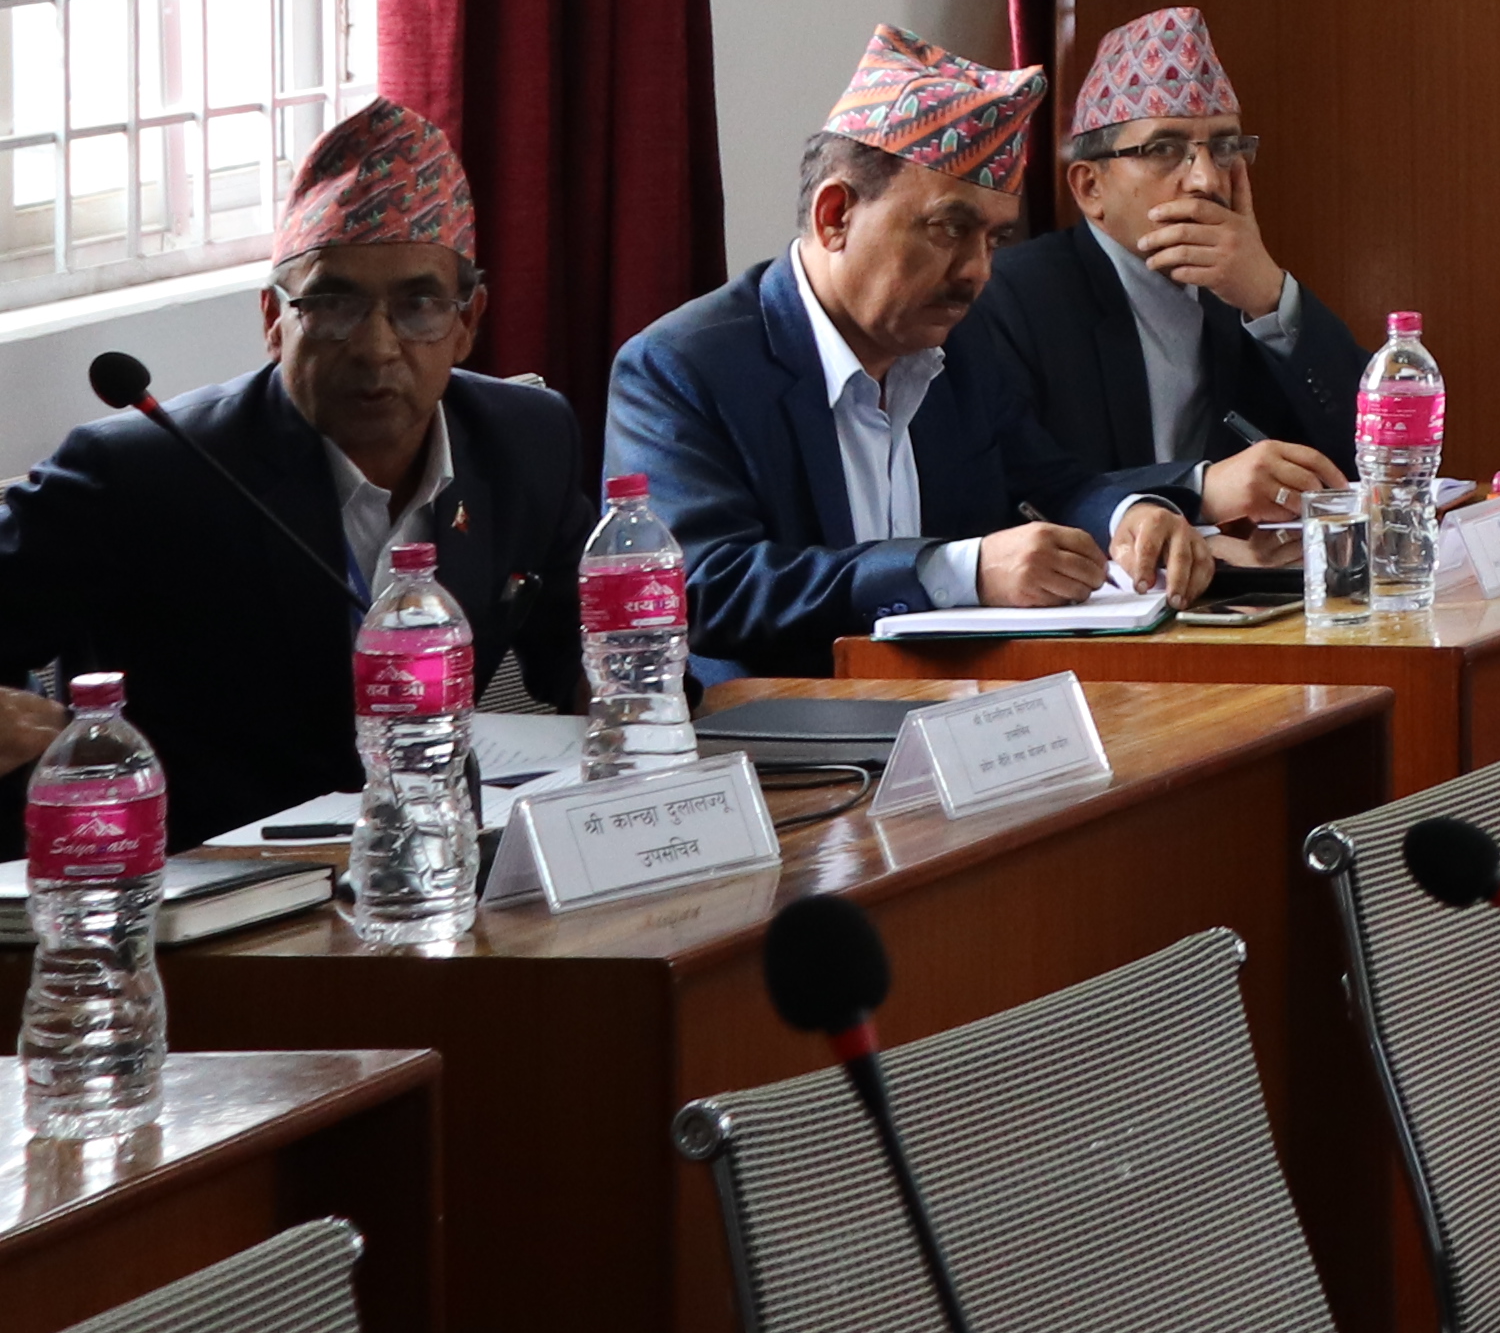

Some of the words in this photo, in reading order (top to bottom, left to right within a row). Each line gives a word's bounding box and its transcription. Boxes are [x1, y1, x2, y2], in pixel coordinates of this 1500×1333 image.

[584, 813, 605, 834] श्री
[609, 805, 659, 831] कान्छा
[663, 790, 733, 826] दुलालज्यू
[637, 836, 701, 867] उपसचिव
